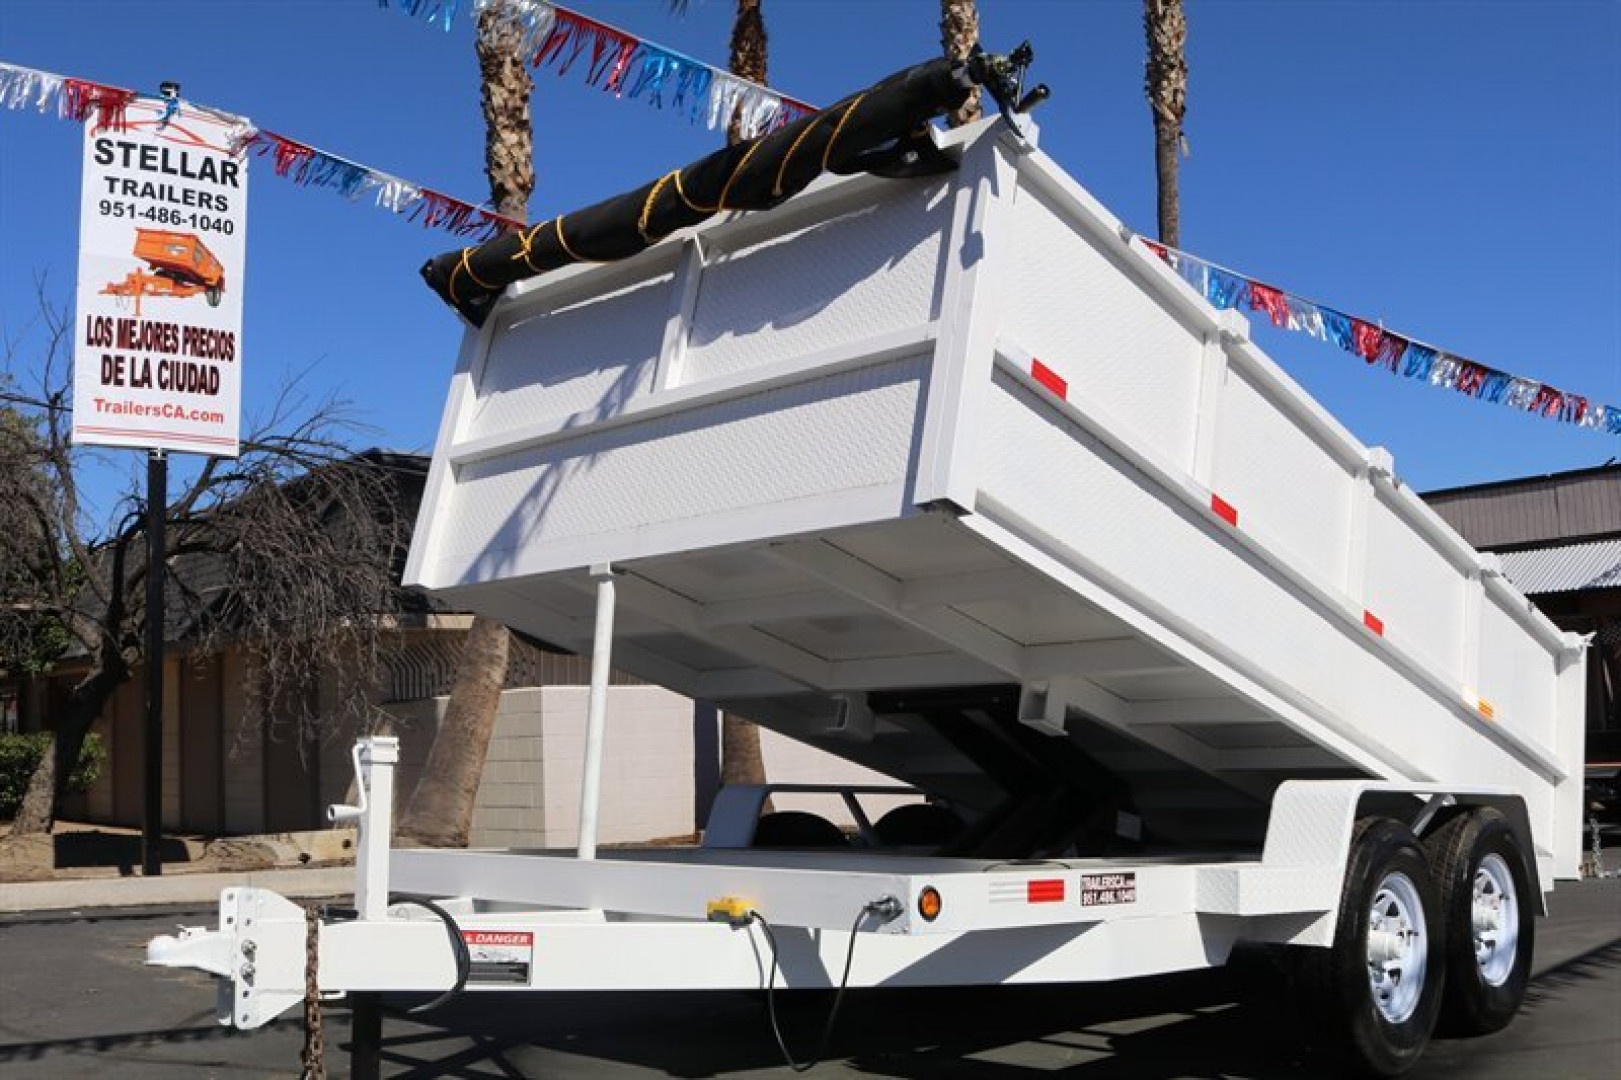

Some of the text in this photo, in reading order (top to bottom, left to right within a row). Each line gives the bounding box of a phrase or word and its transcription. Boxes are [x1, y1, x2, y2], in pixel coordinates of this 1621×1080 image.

[94, 138, 239, 188] STELLAR
[104, 176, 229, 212] TRAILERS
[99, 199, 234, 235] 951-486-1040
[86, 314, 235, 361] LOS MEJORES PRECIOS
[101, 354, 220, 395] DE LA CIUDAD
[94, 398, 224, 424] TrailersCA.com
